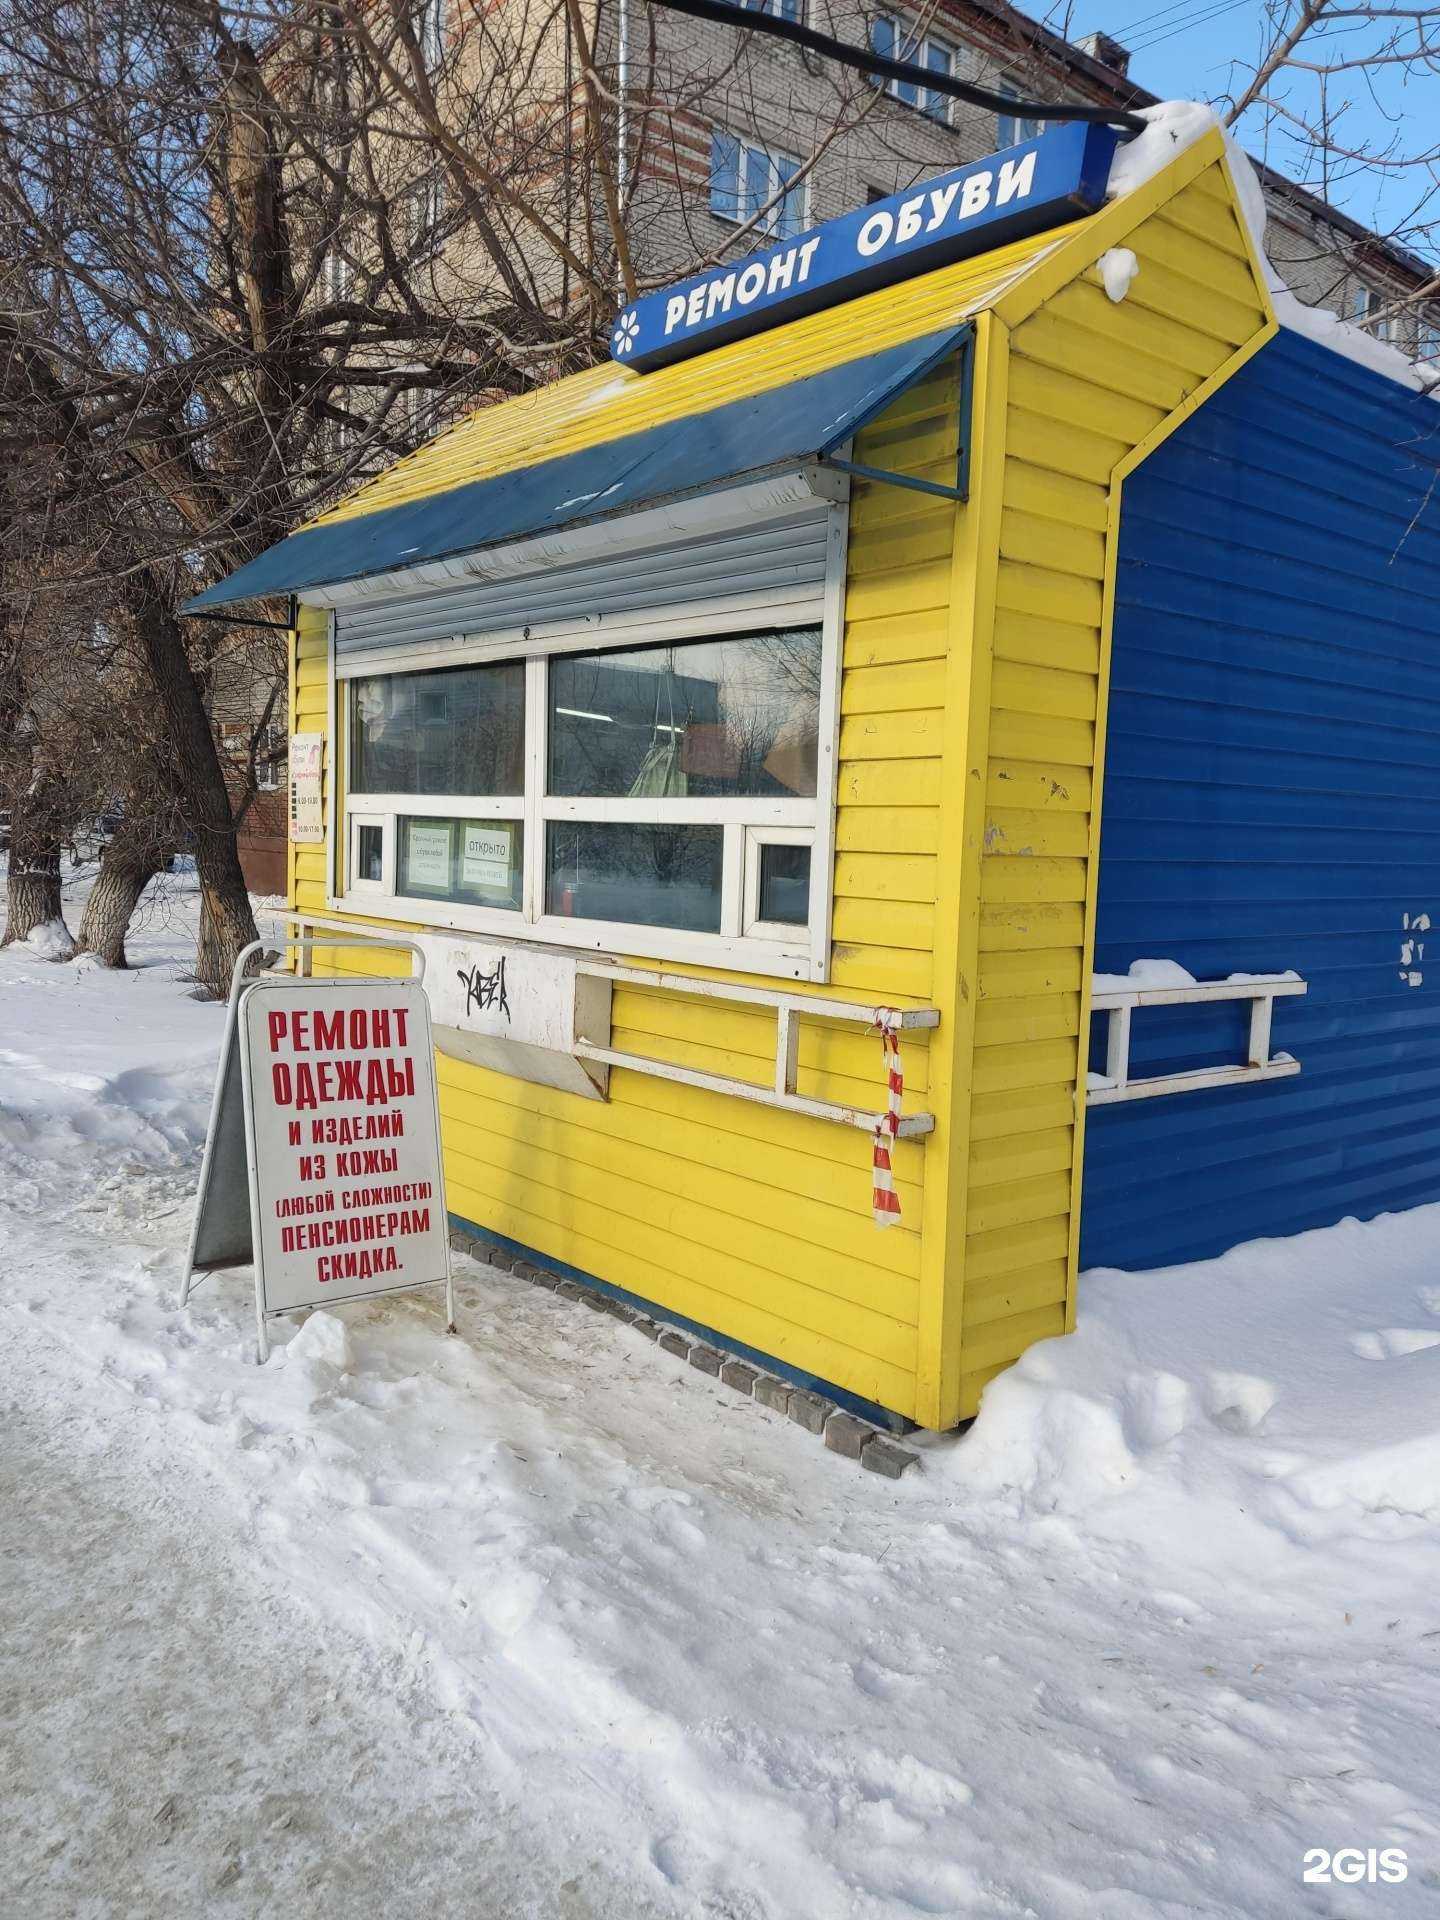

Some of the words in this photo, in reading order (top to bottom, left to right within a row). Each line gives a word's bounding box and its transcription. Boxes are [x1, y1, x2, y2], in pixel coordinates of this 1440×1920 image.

[664, 237, 821, 336] РЕМОНТ
[856, 152, 1037, 256] ОБУВИ
[268, 1008, 409, 1052] РЕМОНТ
[272, 1057, 415, 1110] ОДЕЖДЫ
[289, 1121, 301, 1146] И
[312, 1110, 404, 1146] ИЗДЕЛИЙ
[299, 1154, 326, 1181] ИЗ
[336, 1148, 398, 1177] КОЖЫ
[276, 1190, 335, 1218] (ЛЮБОЙ
[342, 1182, 432, 1210] СЛОЖНОСТИ)
[281, 1208, 430, 1253] ПЕНСИОНЕРАМ
[317, 1246, 403, 1284] СКИДКА.
